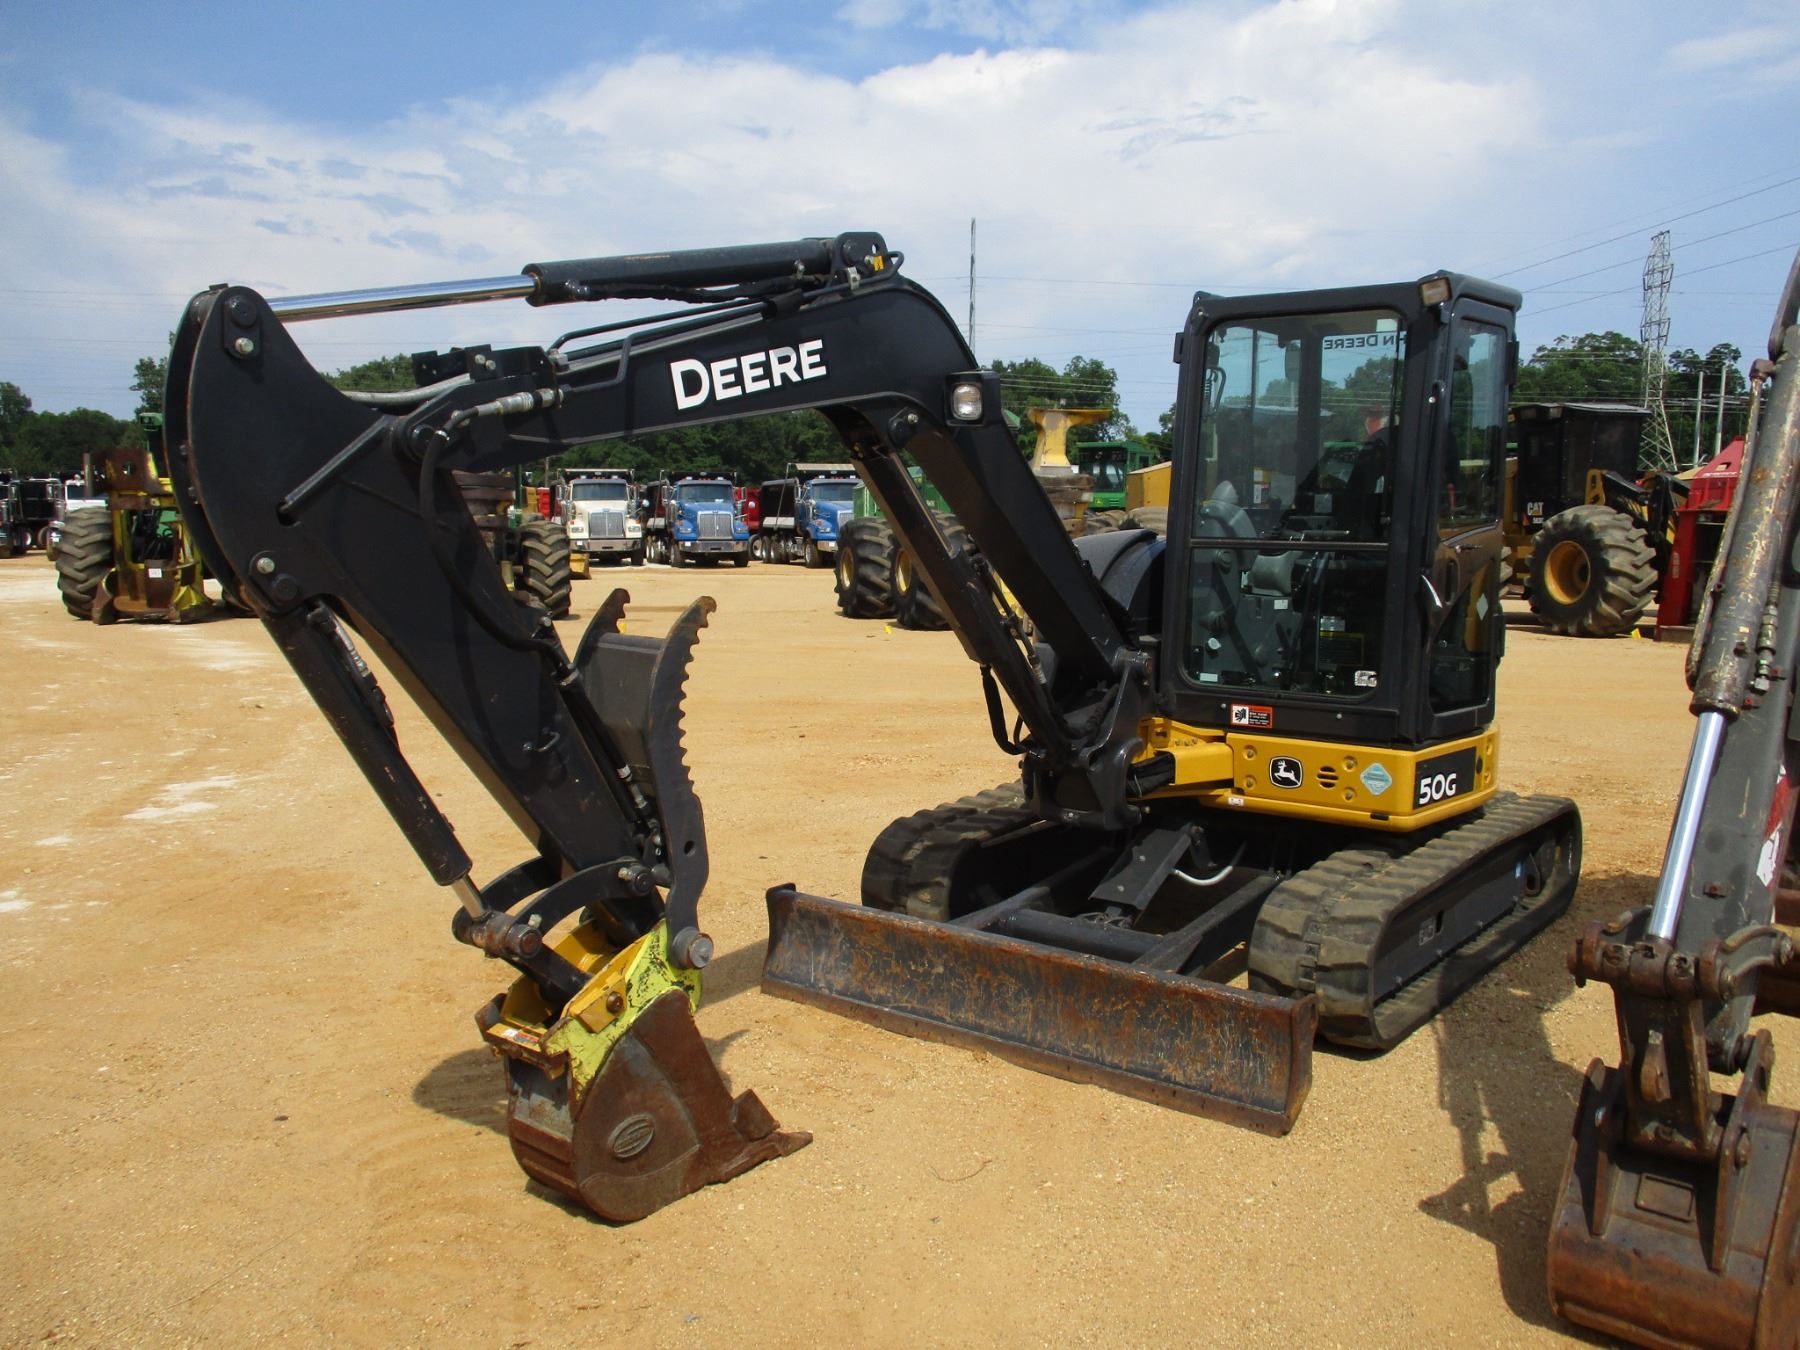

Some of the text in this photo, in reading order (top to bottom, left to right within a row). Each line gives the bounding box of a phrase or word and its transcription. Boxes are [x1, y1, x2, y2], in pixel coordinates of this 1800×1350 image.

[670, 339, 827, 410] DEERE
[1527, 502, 1544, 516] CAT
[1419, 773, 1457, 805] 50G
